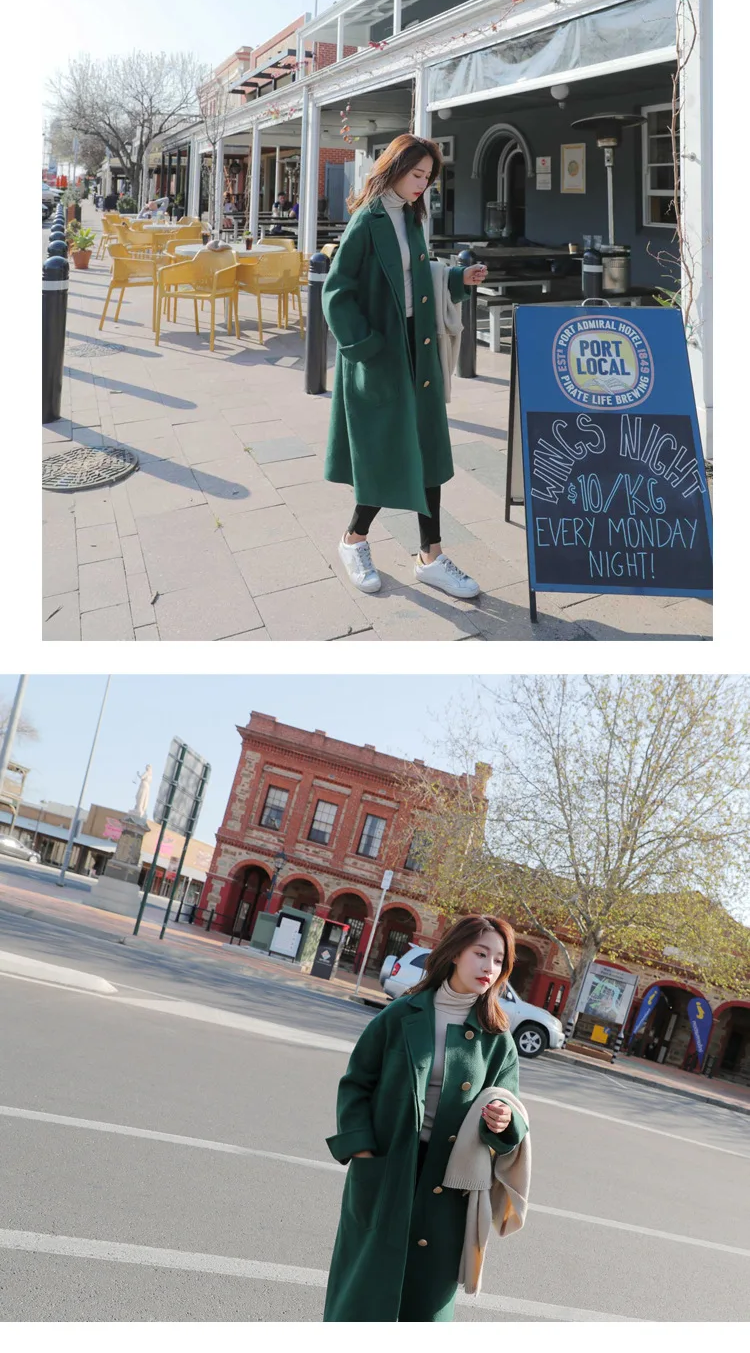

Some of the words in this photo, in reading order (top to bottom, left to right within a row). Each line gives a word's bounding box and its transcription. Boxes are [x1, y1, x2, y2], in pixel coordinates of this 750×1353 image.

[558, 324, 576, 347] PORT
[577, 319, 617, 331] ADMIRAL
[618, 323, 643, 348] HOTEL
[637, 348, 650, 374] 1849
[579, 340, 622, 357] PORT
[576, 358, 631, 376] LOCAL
[561, 374, 589, 403] PIRATE
[592, 394, 613, 405] LIFE
[615, 375, 650, 405] BREWING
[531, 413, 606, 504] WINGS
[619, 414, 706, 498] NIGHT
[567, 473, 666, 515] $10/KG
[535, 517, 596, 547] EVERY
[608, 517, 698, 549] MONDAY
[588, 550, 655, 580] NIGHT!
